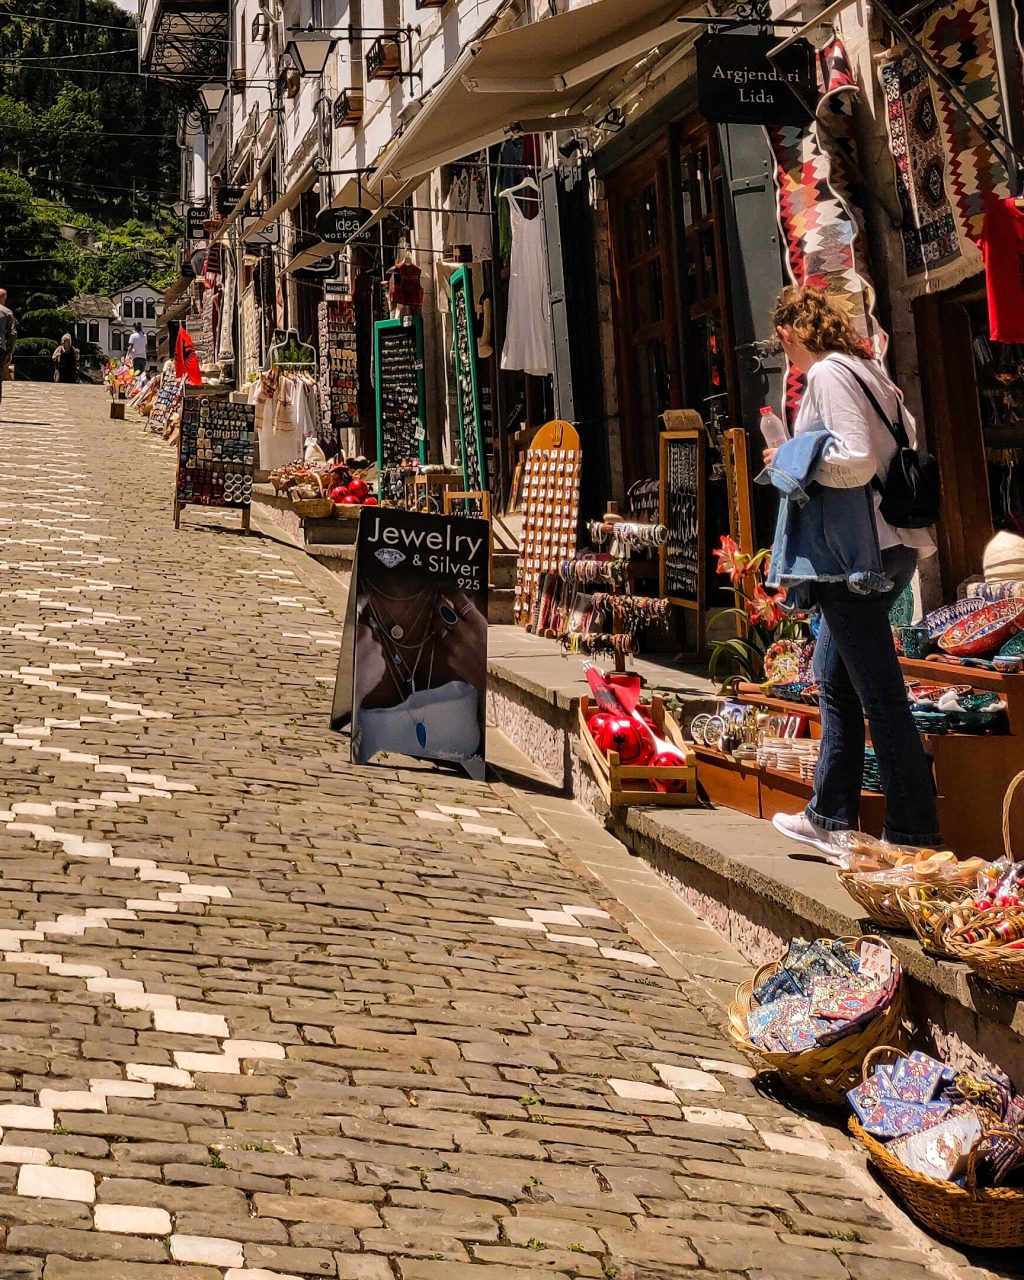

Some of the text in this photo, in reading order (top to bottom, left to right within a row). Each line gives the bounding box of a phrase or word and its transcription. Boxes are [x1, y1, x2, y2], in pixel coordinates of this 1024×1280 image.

[739, 88, 775, 104] Lida
[335, 217, 360, 231] idea
[367, 517, 483, 561] Jewelry
[412, 554, 480, 577] & Silver
[457, 577, 480, 590] 925
